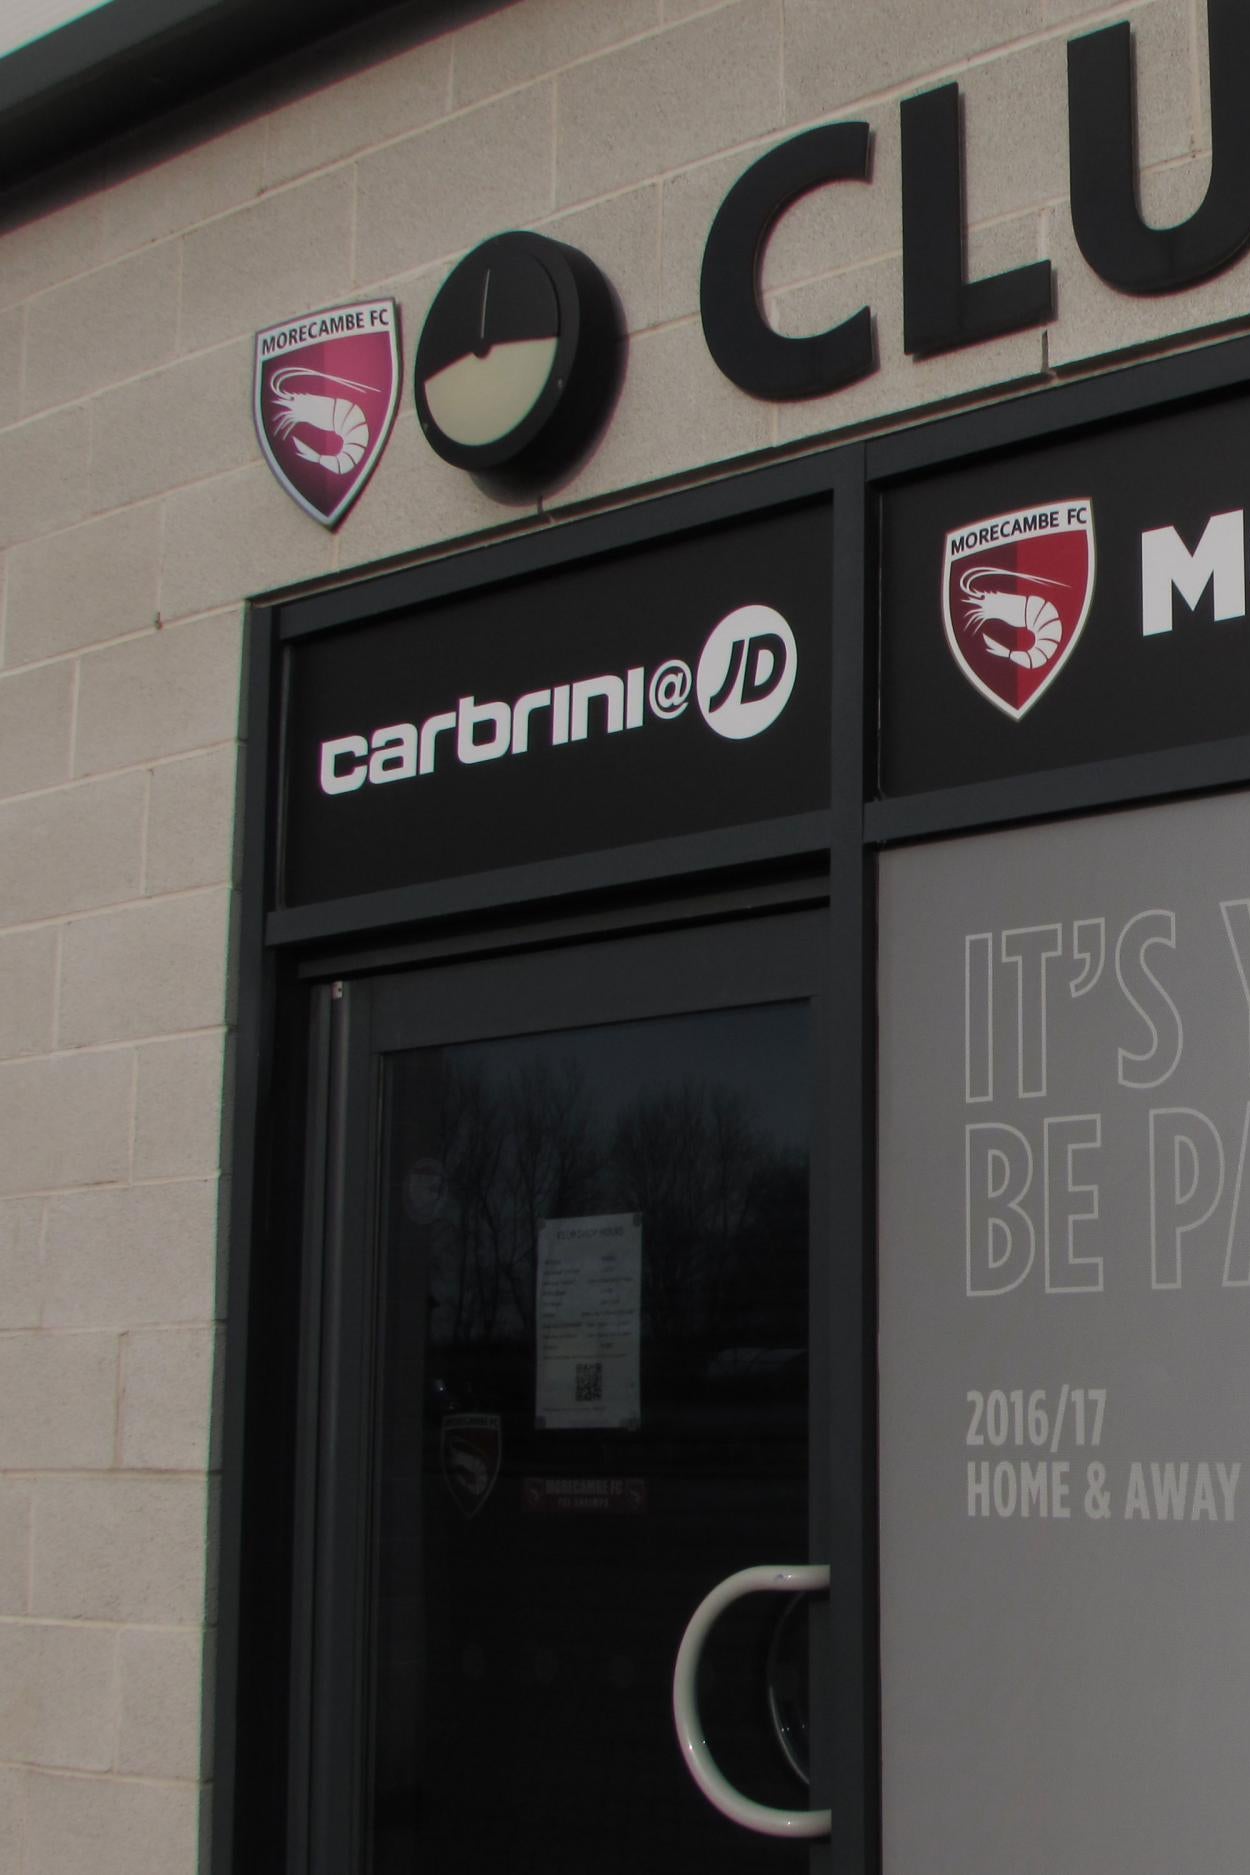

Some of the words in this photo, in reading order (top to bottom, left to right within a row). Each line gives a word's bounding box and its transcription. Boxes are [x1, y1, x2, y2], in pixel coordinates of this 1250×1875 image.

[262, 313, 365, 355] MORECAMBE
[370, 309, 389, 327] FC
[951, 512, 1060, 555] MORECAMBE
[1067, 507, 1087, 525] FC
[965, 1114, 1105, 1297] BE
[966, 1384, 1108, 1452] 2016/17
[967, 1461, 1071, 1518] HOME
[1083, 1462, 1111, 1519] &
[1125, 1462, 1242, 1521] AWAY
